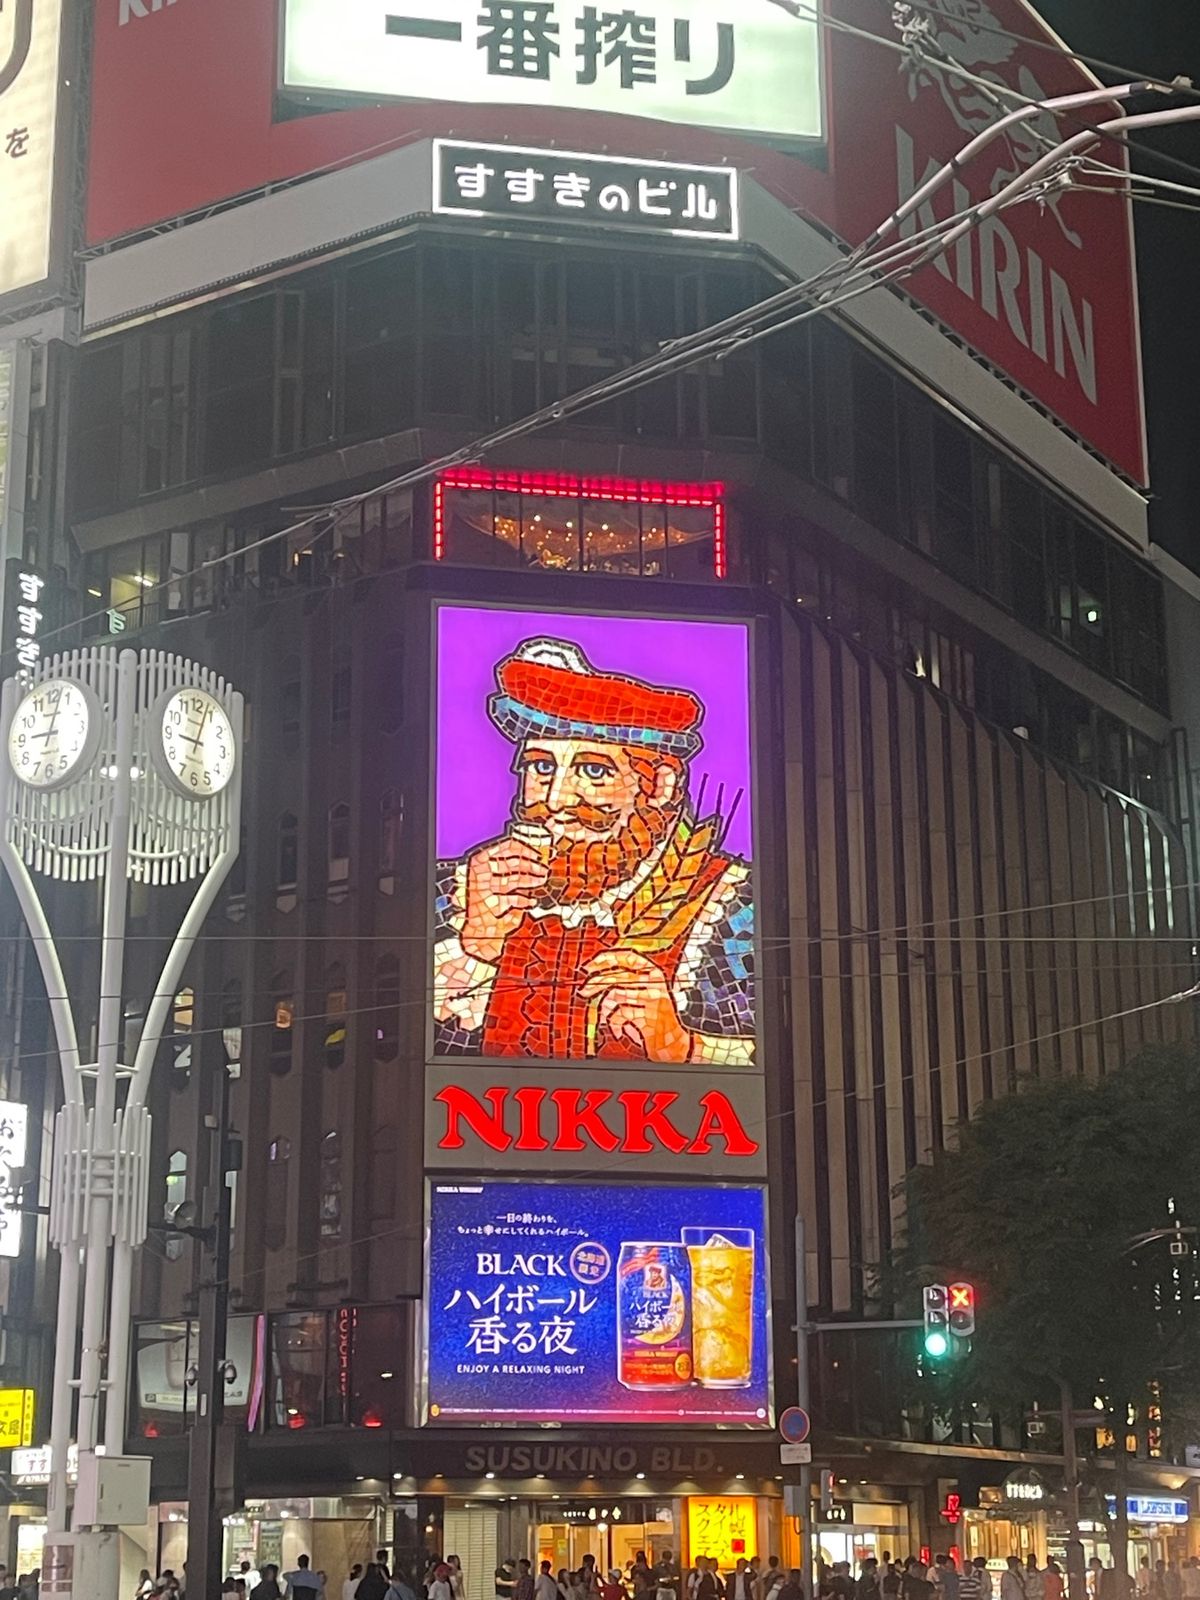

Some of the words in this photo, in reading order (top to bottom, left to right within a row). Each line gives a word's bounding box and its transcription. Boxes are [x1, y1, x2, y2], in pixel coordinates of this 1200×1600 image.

[384, 0, 736, 95] 一番搾り
[5, 127, 29, 158] を
[454, 162, 718, 219] すすきのビル
[895, 123, 1098, 407] KIRIN
[33, 697, 44, 713] 11
[179, 698, 189, 715] 11
[191, 697, 204, 714] 12
[22, 714, 36, 729] 10
[169, 710, 181, 726] 10
[208, 709, 214, 724] 1
[18, 733, 26, 748] 9
[165, 725, 173, 740] 9
[216, 725, 223, 740] 2
[21, 751, 30, 766] 8
[169, 746, 176, 761] 8
[219, 745, 226, 760] 3
[33, 761, 42, 777] 7
[59, 755, 68, 770] 5
[179, 762, 187, 777] 7
[45, 763, 54, 779] 6
[190, 771, 198, 787] 6
[203, 771, 212, 786] 5
[434, 1085, 759, 1156] NIKKA
[476, 1253, 567, 1277] BLACK
[443, 1283, 598, 1315] ハイボール
[465, 1314, 578, 1355] 香る夜
[456, 1363, 490, 1374] ENJOY
[492, 1364, 500, 1374] A
[502, 1364, 551, 1375] RELAXING
[553, 1365, 586, 1375] NIGHT
[465, 1446, 638, 1472] SUSUKINO
[651, 1447, 724, 1473] BLD.
